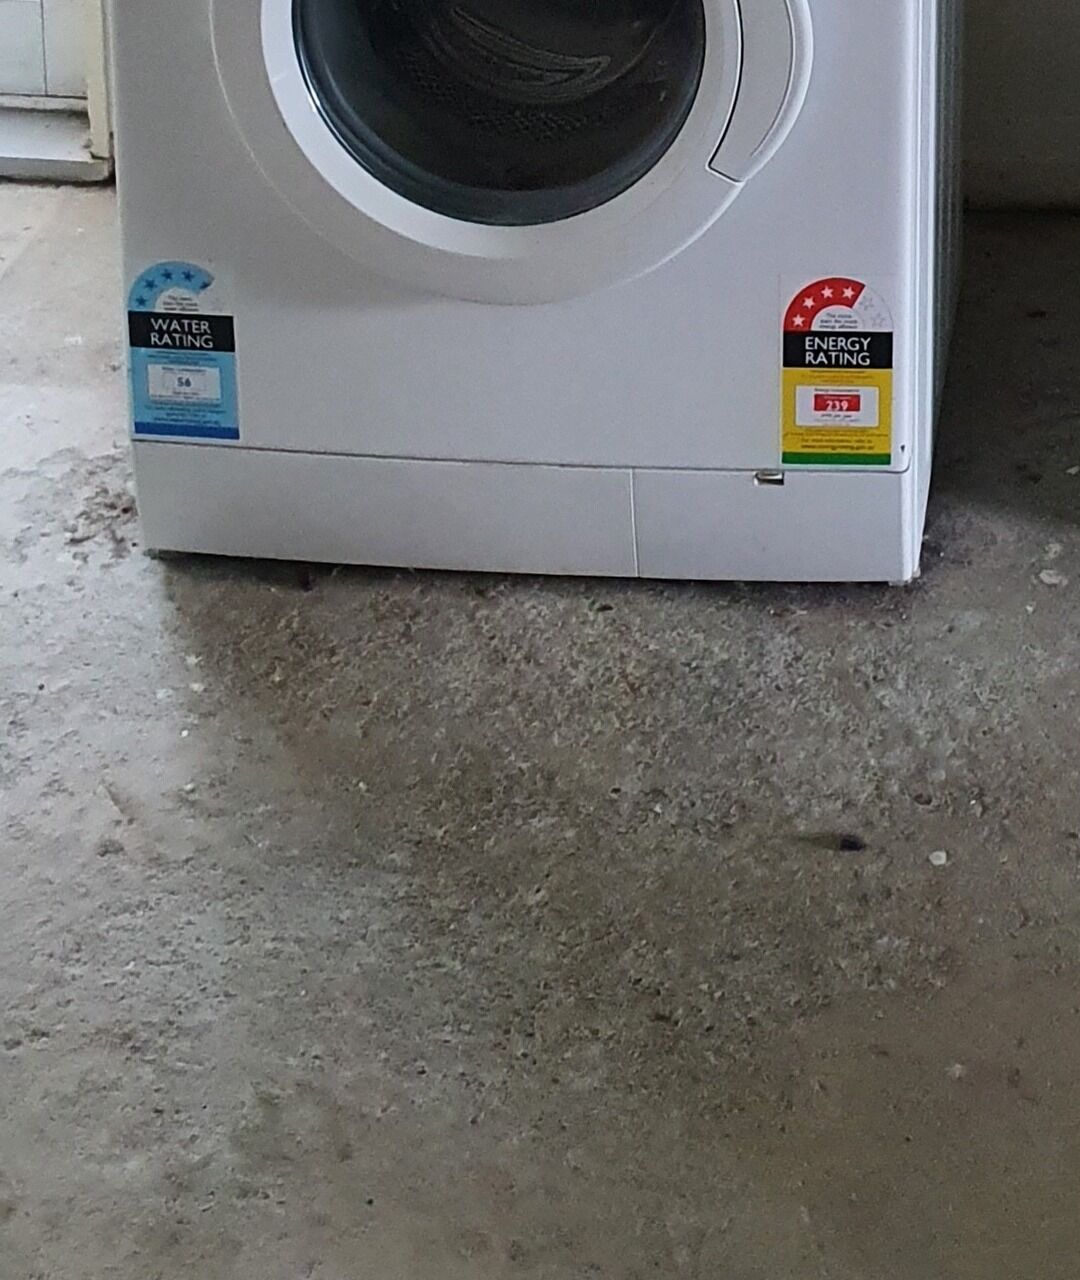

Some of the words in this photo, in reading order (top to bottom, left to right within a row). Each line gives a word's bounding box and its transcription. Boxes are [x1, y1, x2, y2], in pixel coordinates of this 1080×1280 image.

[150, 317, 211, 334] WATER
[150, 332, 214, 348] RATING
[804, 336, 871, 352] ENERGY
[805, 351, 871, 366] RATING
[177, 377, 192, 388] 56
